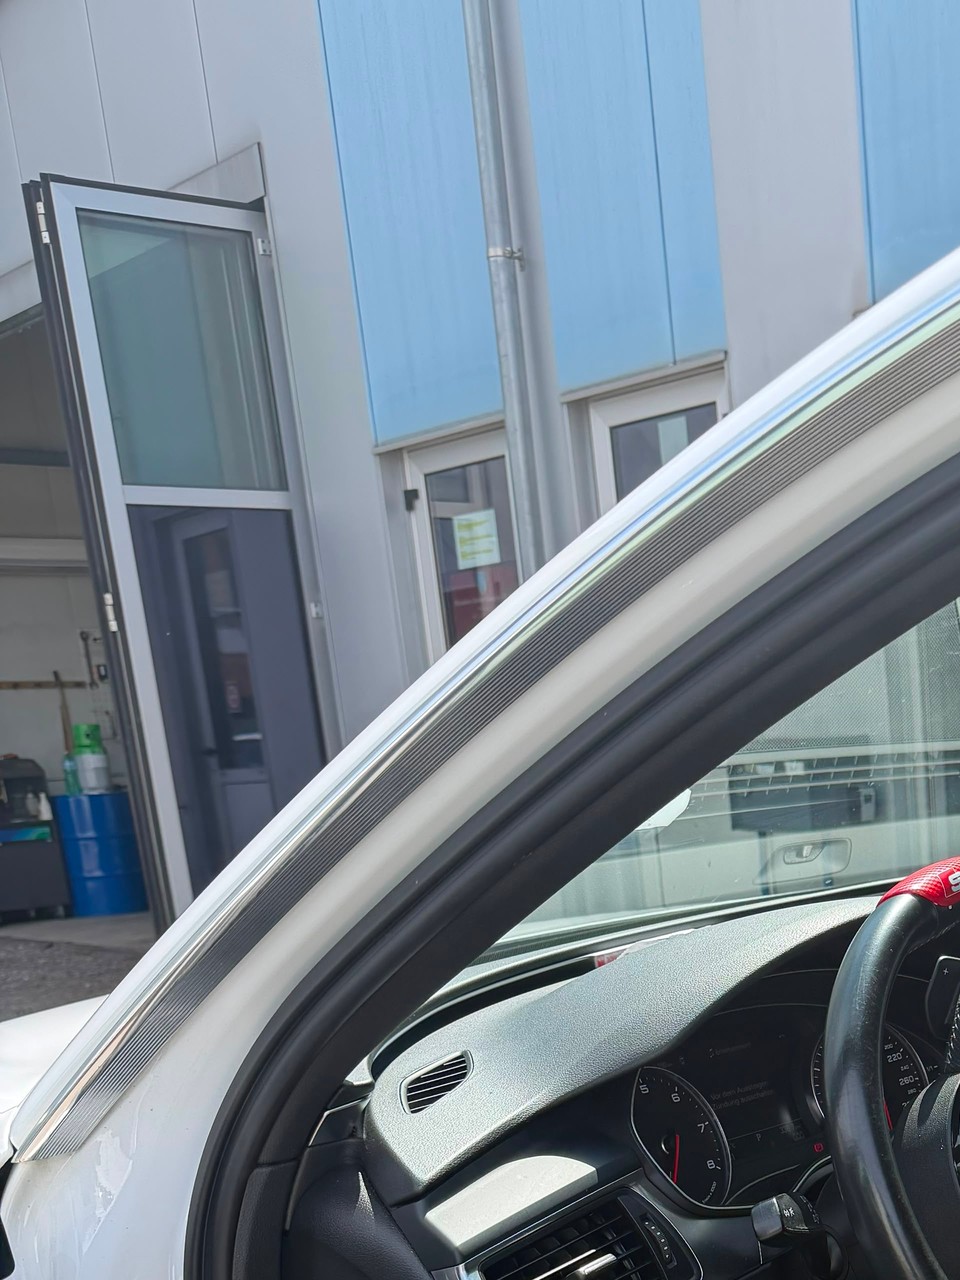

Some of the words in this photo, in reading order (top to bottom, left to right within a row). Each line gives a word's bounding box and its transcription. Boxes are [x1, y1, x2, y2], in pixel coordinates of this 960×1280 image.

[887, 1052, 902, 1063] 220
[899, 1075, 915, 1086] 260
[640, 1084, 650, 1095] 5
[670, 1092, 681, 1103] 6
[697, 1123, 706, 1134] 7
[706, 1159, 716, 1170] 8
